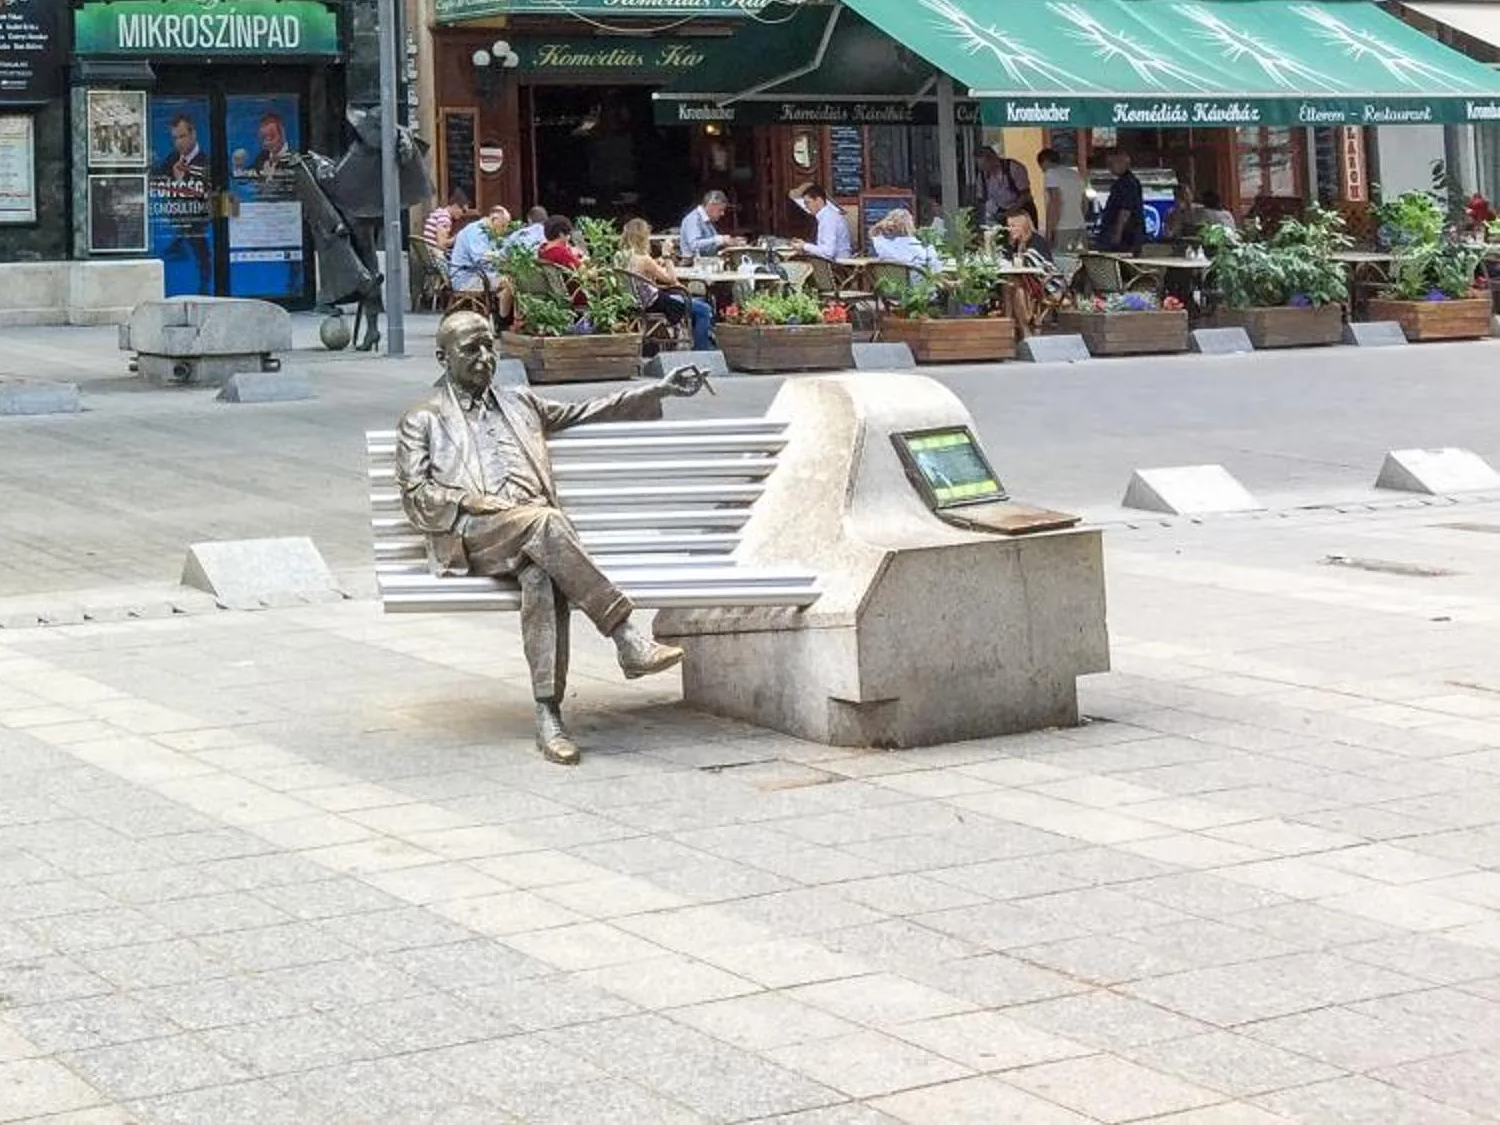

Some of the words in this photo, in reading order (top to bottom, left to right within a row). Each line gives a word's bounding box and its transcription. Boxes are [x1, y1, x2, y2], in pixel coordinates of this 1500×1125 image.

[118, 7, 300, 48] MIKROSZÍNPAD
[1006, 102, 1071, 122] Krombacher
[1112, 102, 1189, 123] Komédiás
[1191, 102, 1261, 123] Kávéház
[1361, 104, 1433, 122] Restaurant
